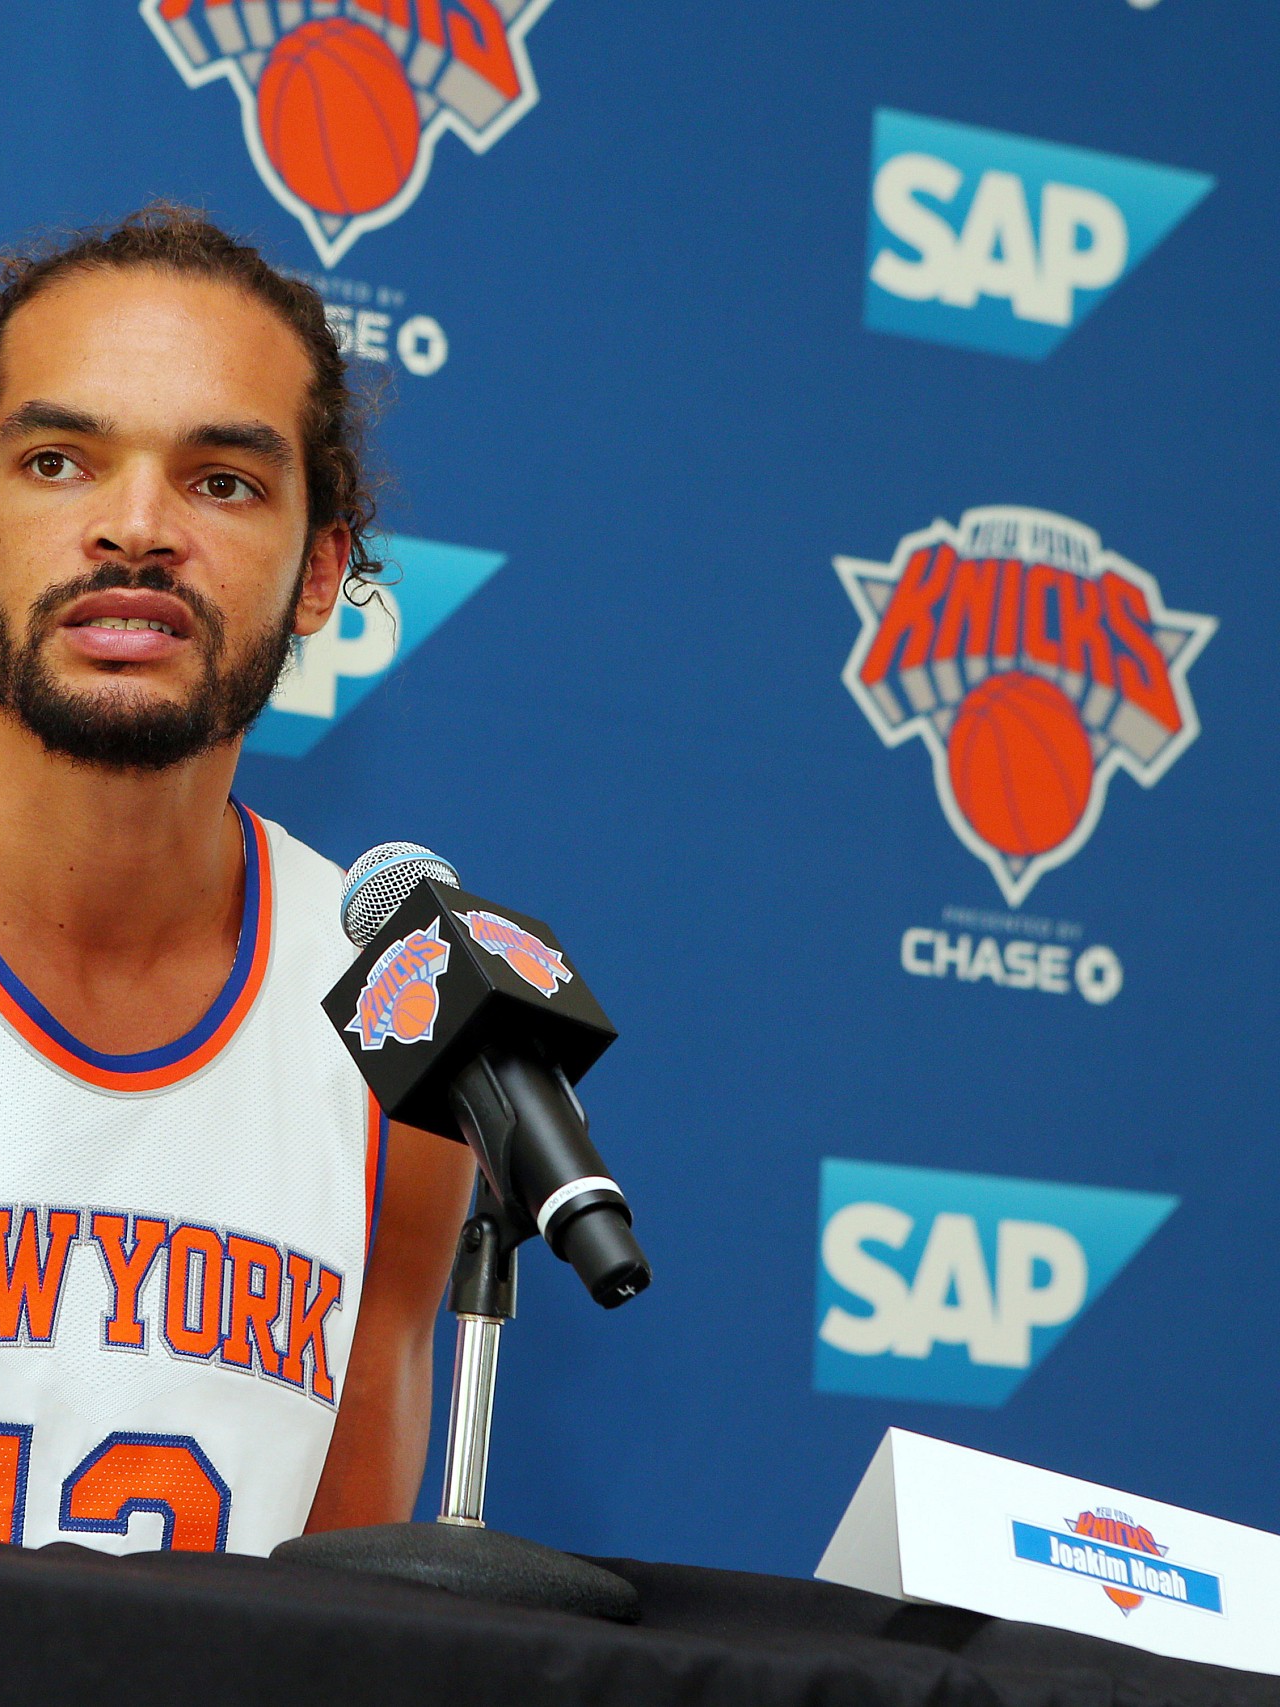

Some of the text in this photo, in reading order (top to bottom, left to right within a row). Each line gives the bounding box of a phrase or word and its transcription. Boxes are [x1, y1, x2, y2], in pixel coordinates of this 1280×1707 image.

[869, 151, 1129, 328] SAP
[859, 543, 1183, 735] KNICKS
[360, 932, 448, 1047] KNICKS
[368, 943, 404, 986] NEW YORK
[471, 914, 569, 975] KNICKS
[900, 926, 1071, 995] CHASE
[86, 1204, 346, 1413] YORK
[819, 1201, 1089, 1369] SAP
[1049, 1535, 1188, 1601] Joakim Noah
